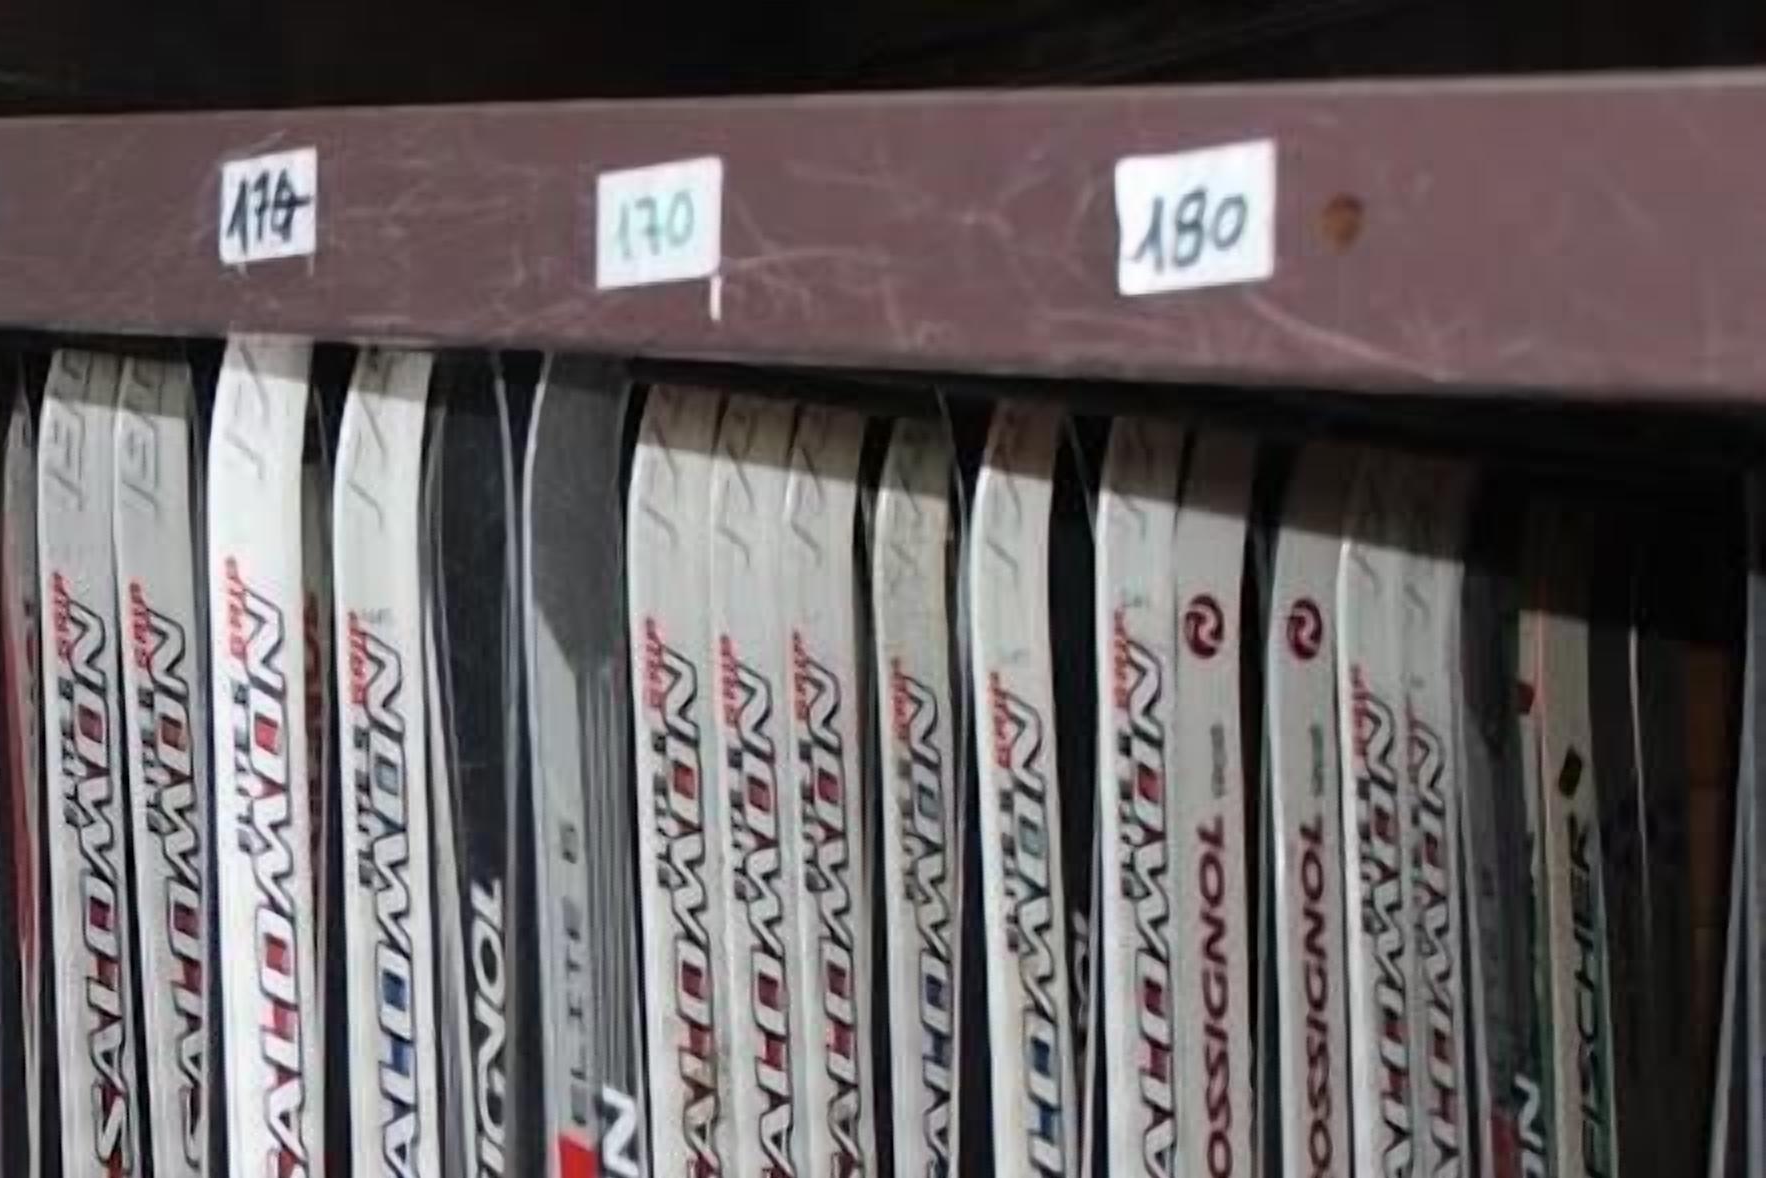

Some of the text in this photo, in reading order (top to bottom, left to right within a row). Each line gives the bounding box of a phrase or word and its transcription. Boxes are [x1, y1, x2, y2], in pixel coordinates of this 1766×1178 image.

[617, 191, 696, 260] 170
[1134, 188, 1250, 275] 180
[67, 600, 132, 1176] SALOMON
